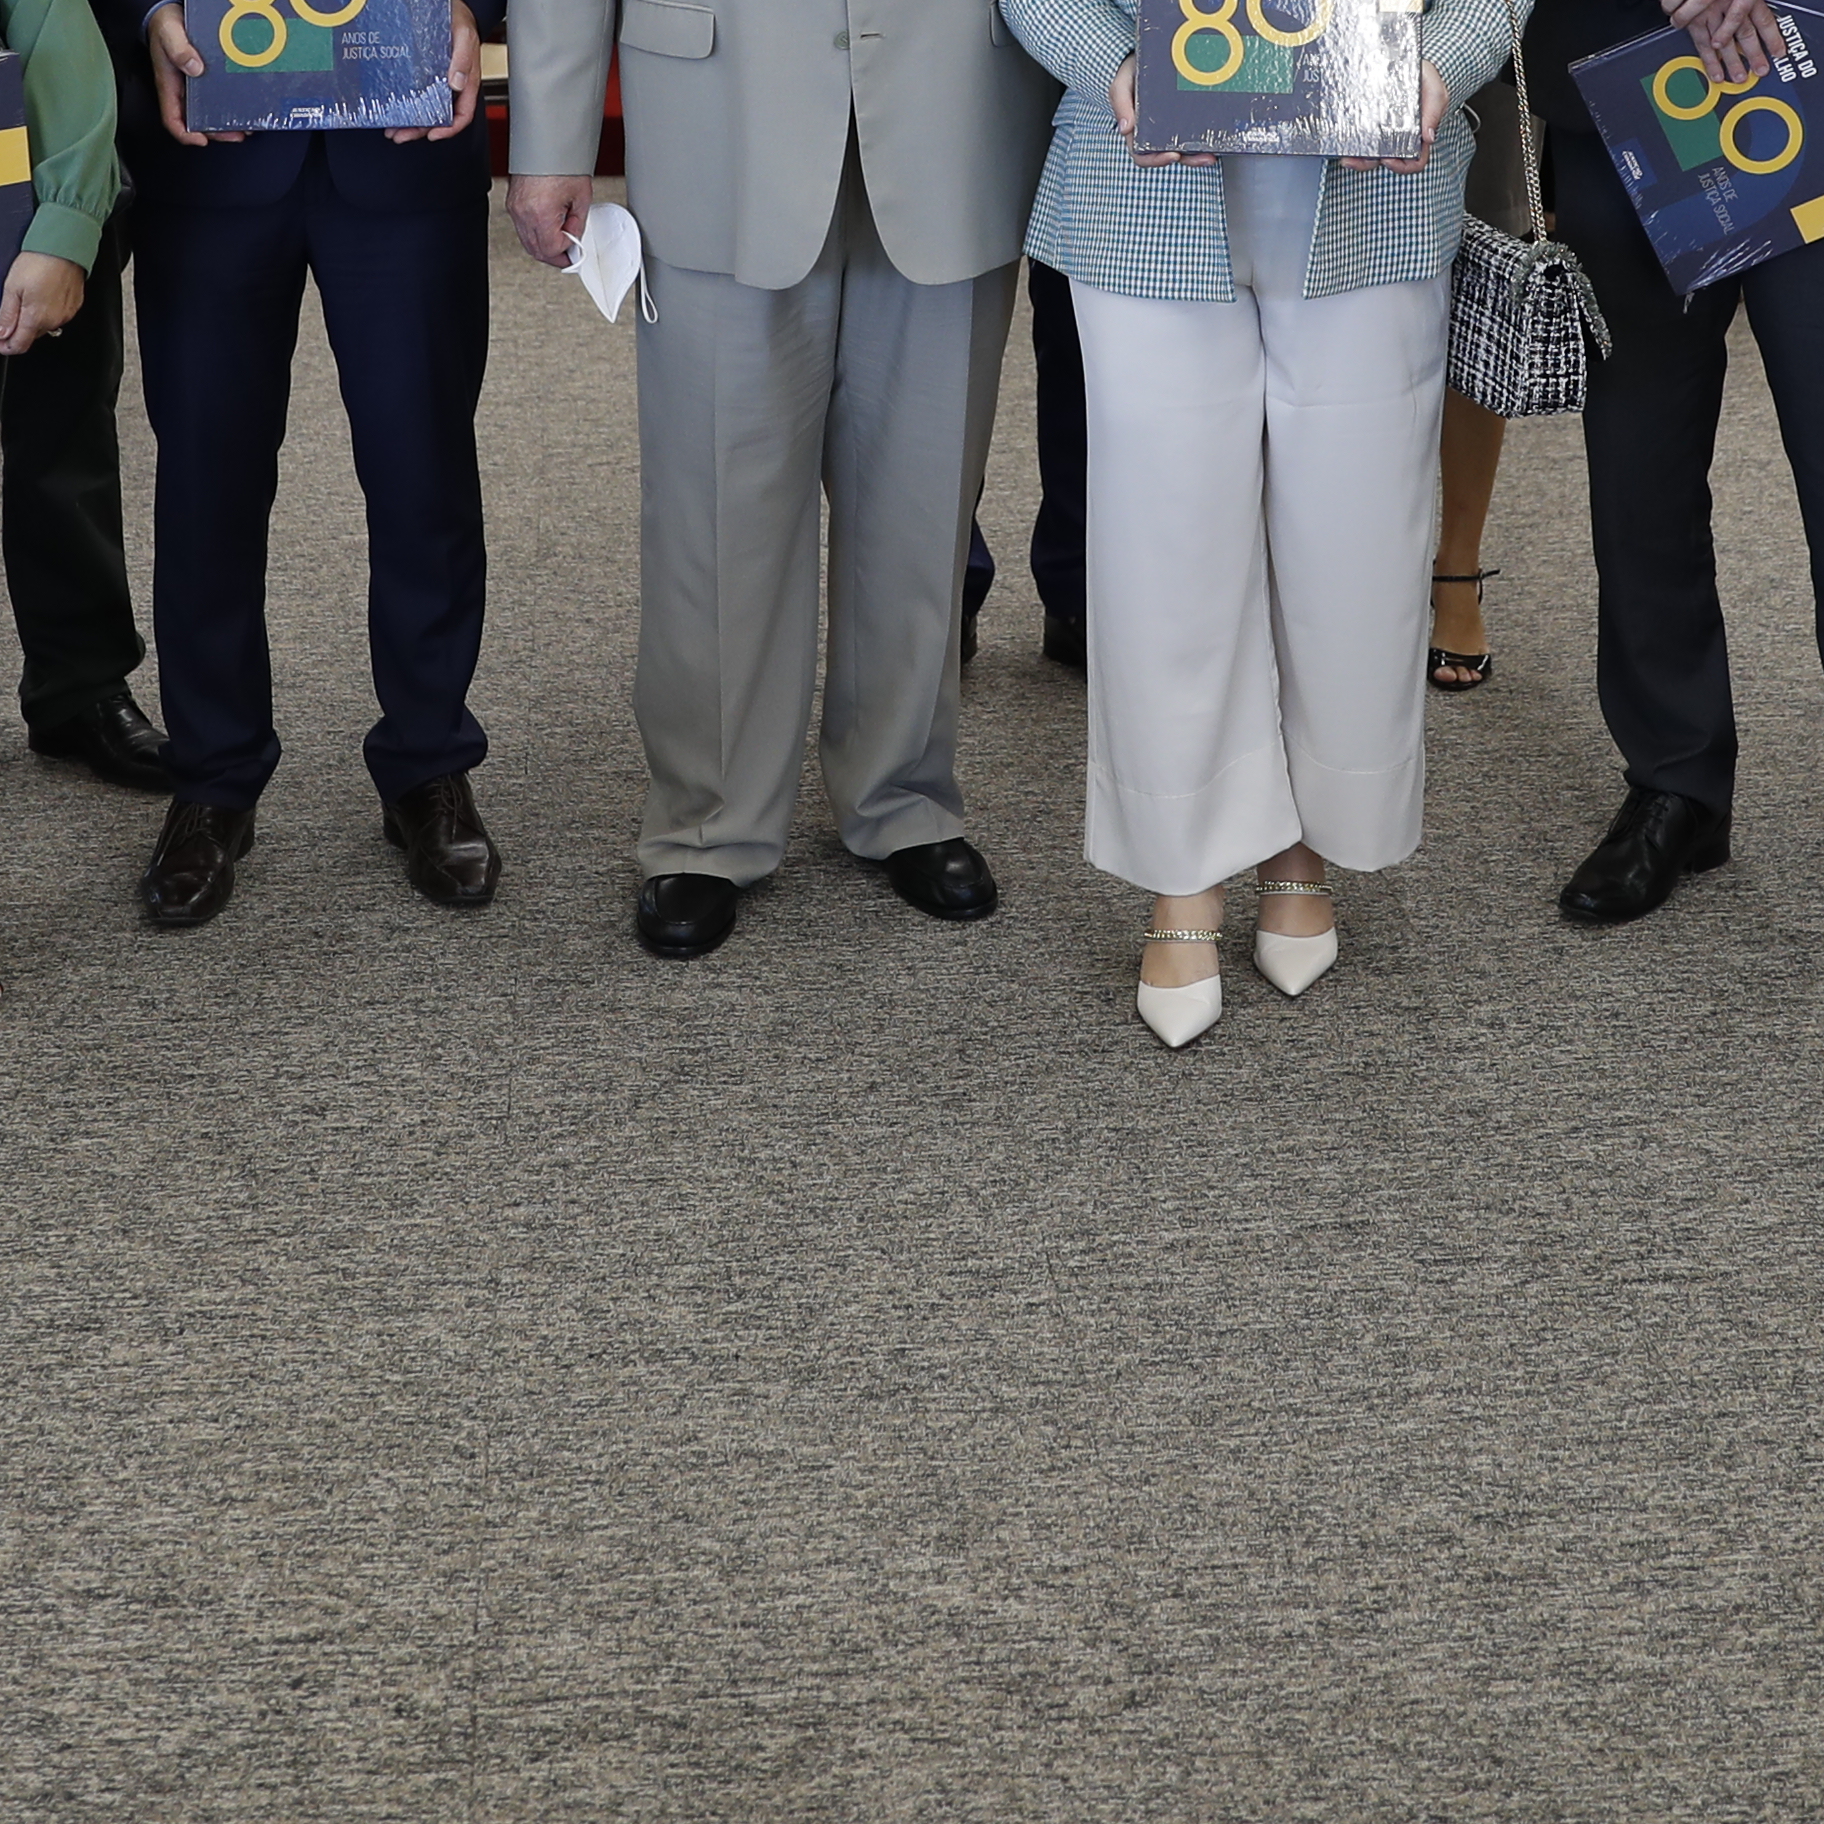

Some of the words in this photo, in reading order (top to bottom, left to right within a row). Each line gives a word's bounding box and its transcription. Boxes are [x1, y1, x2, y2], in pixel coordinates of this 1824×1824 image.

[341, 31, 366, 45] ANOS
[368, 31, 380, 44] DE
[342, 46, 378, 62] JUSTIÇA
[379, 46, 412, 59] SOCIAL
[1776, 14, 1809, 62] JUSTIÇA
[1797, 59, 1817, 78] DO
[1652, 52, 1804, 174] 80
[1711, 166, 1732, 190] ANOS
[1722, 188, 1738, 203] DE
